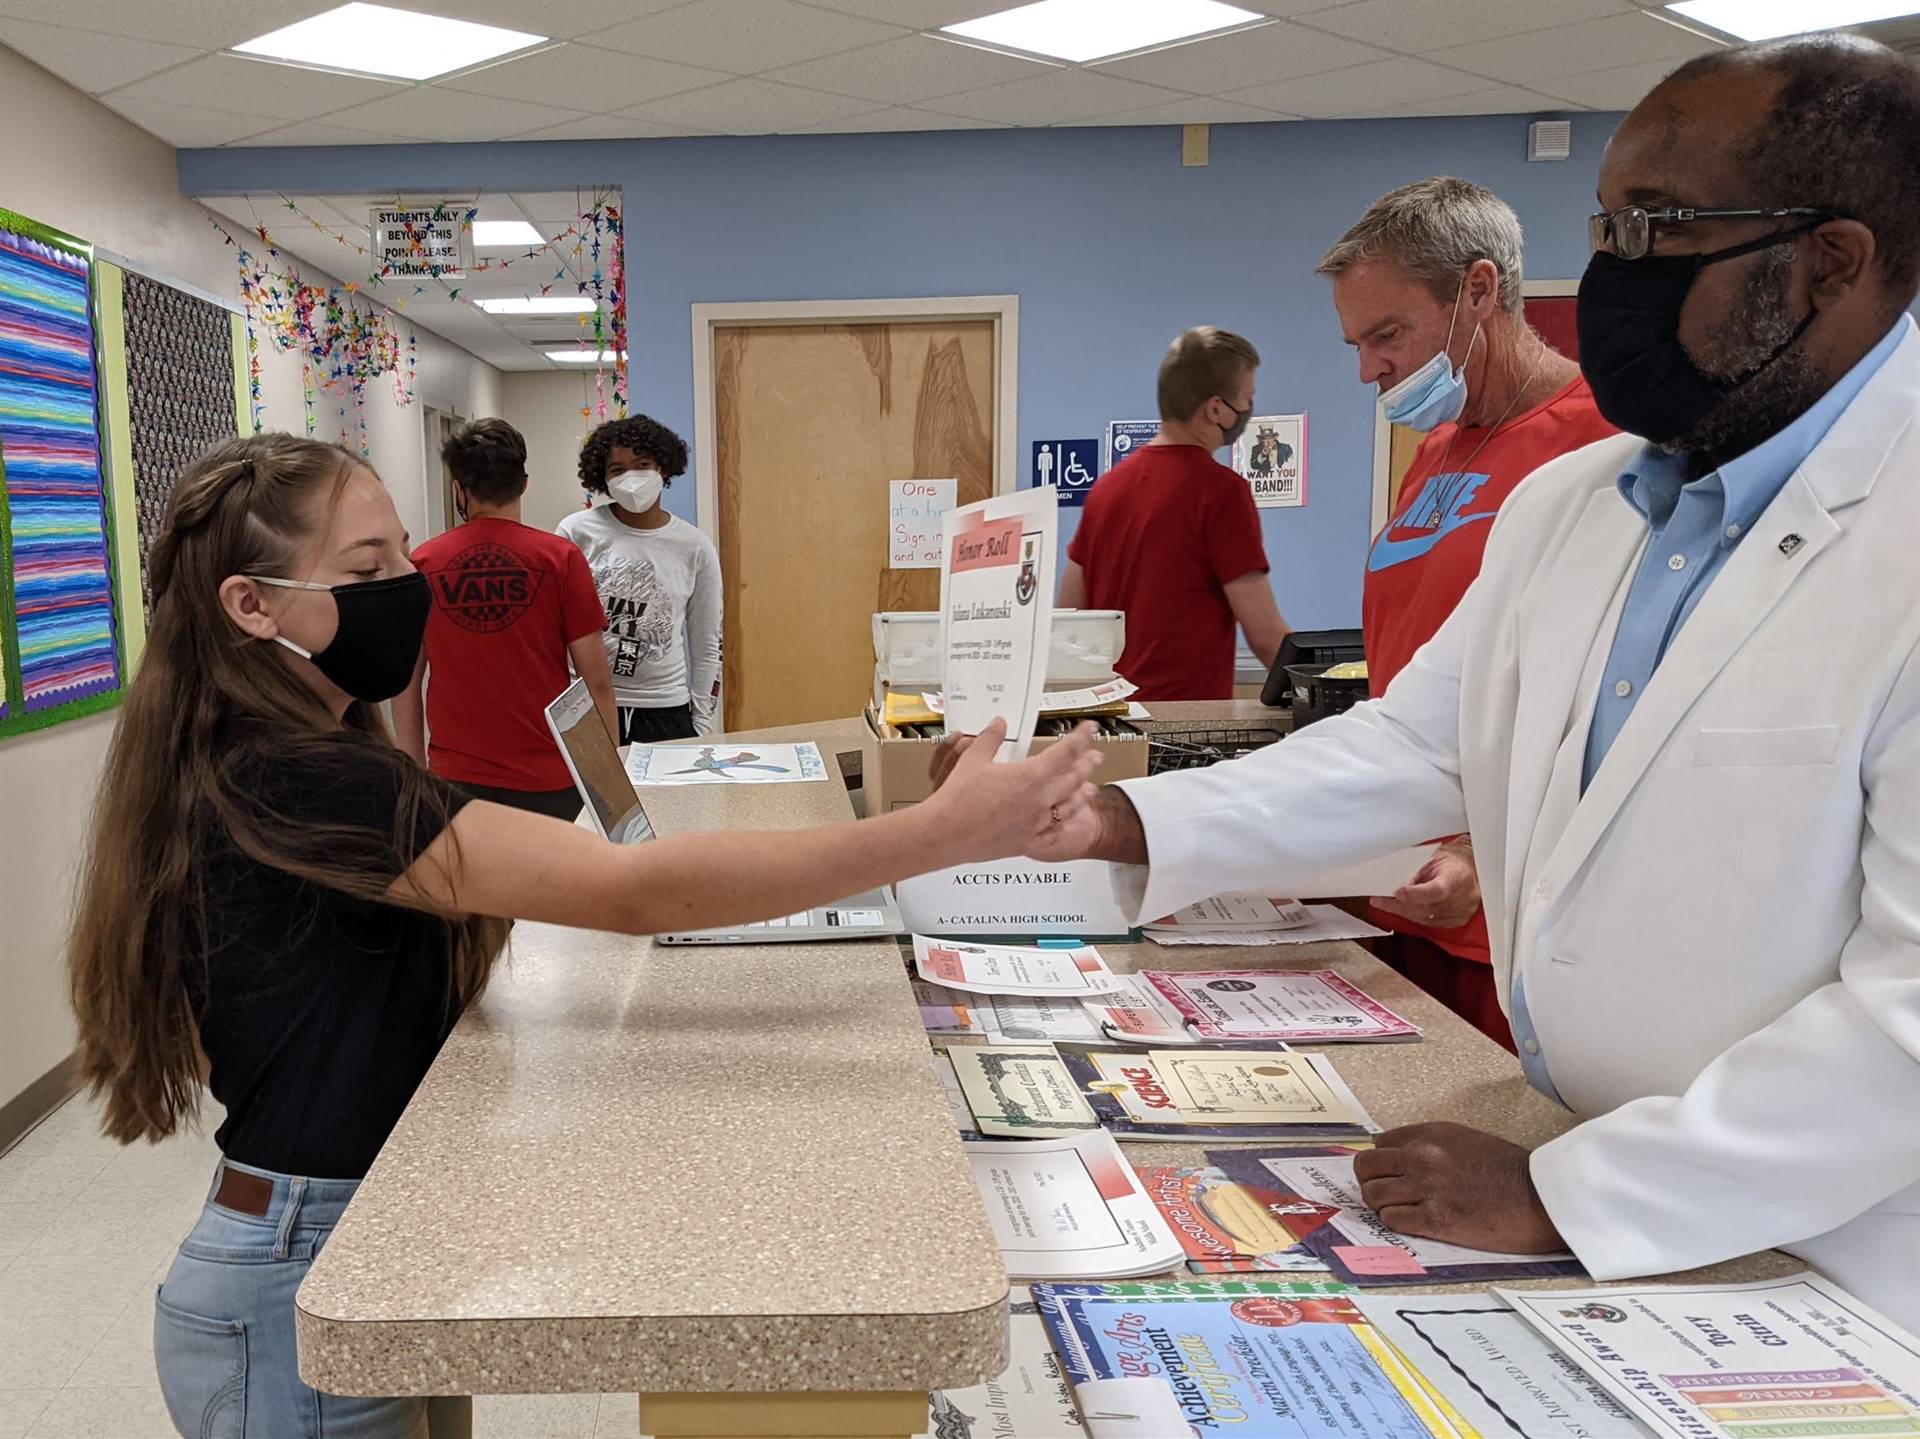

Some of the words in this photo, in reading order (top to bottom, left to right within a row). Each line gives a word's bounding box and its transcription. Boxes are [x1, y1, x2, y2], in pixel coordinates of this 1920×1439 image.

[379, 212, 430, 223] STUDENTS
[433, 211, 459, 221] ONLY
[388, 230, 427, 240] BEYOND
[431, 229, 452, 239] THIS
[385, 248, 414, 257] POINT
[393, 264, 425, 275] THANK
[1246, 470, 1275, 480] WANT
[1276, 468, 1296, 479] YOU
[1254, 479, 1293, 493] BAND!!!
[902, 481, 938, 497] One
[1393, 472, 1492, 528] NIKE
[892, 502, 908, 518] at
[911, 507, 920, 517] a
[895, 523, 926, 548] Sign
[957, 538, 985, 563] Honor
[985, 530, 1013, 558] Roll
[894, 549, 914, 561] and
[923, 547, 943, 561] out
[438, 570, 528, 604] VANS
[615, 640, 639, 676] 東京
[952, 873, 1001, 885] ACCTS
[1003, 872, 1072, 884] PAYABLE
[950, 915, 1007, 925] CATALINA
[1010, 914, 1039, 924] HIGH
[1040, 914, 1088, 924] SCHOOL
[1120, 1067, 1177, 1109] SCIENCE
[1152, 1174, 1190, 1209] Artist
[1633, 1303, 1667, 1325] awarded
[1661, 1323, 1673, 1331] is
[1103, 1312, 1154, 1356] Arts
[1561, 1323, 1627, 1363] Award
[1670, 1329, 1707, 1358] certificate
[1684, 1315, 1738, 1348] Torry
[1733, 1313, 1789, 1347] Citrin
[1230, 1333, 1271, 1382] Drechsler
[1464, 1328, 1510, 1363] AWARD
[1704, 1354, 1724, 1369] This
[1141, 1326, 1220, 1429] Achievement
[1176, 1331, 1249, 1424] Certificate
[1678, 1370, 1842, 1387] CITIZENSHIP
[1260, 1381, 1296, 1419] Martin
[1504, 1364, 1570, 1419] IMPROVED
[1735, 1388, 1834, 1400] CARING
